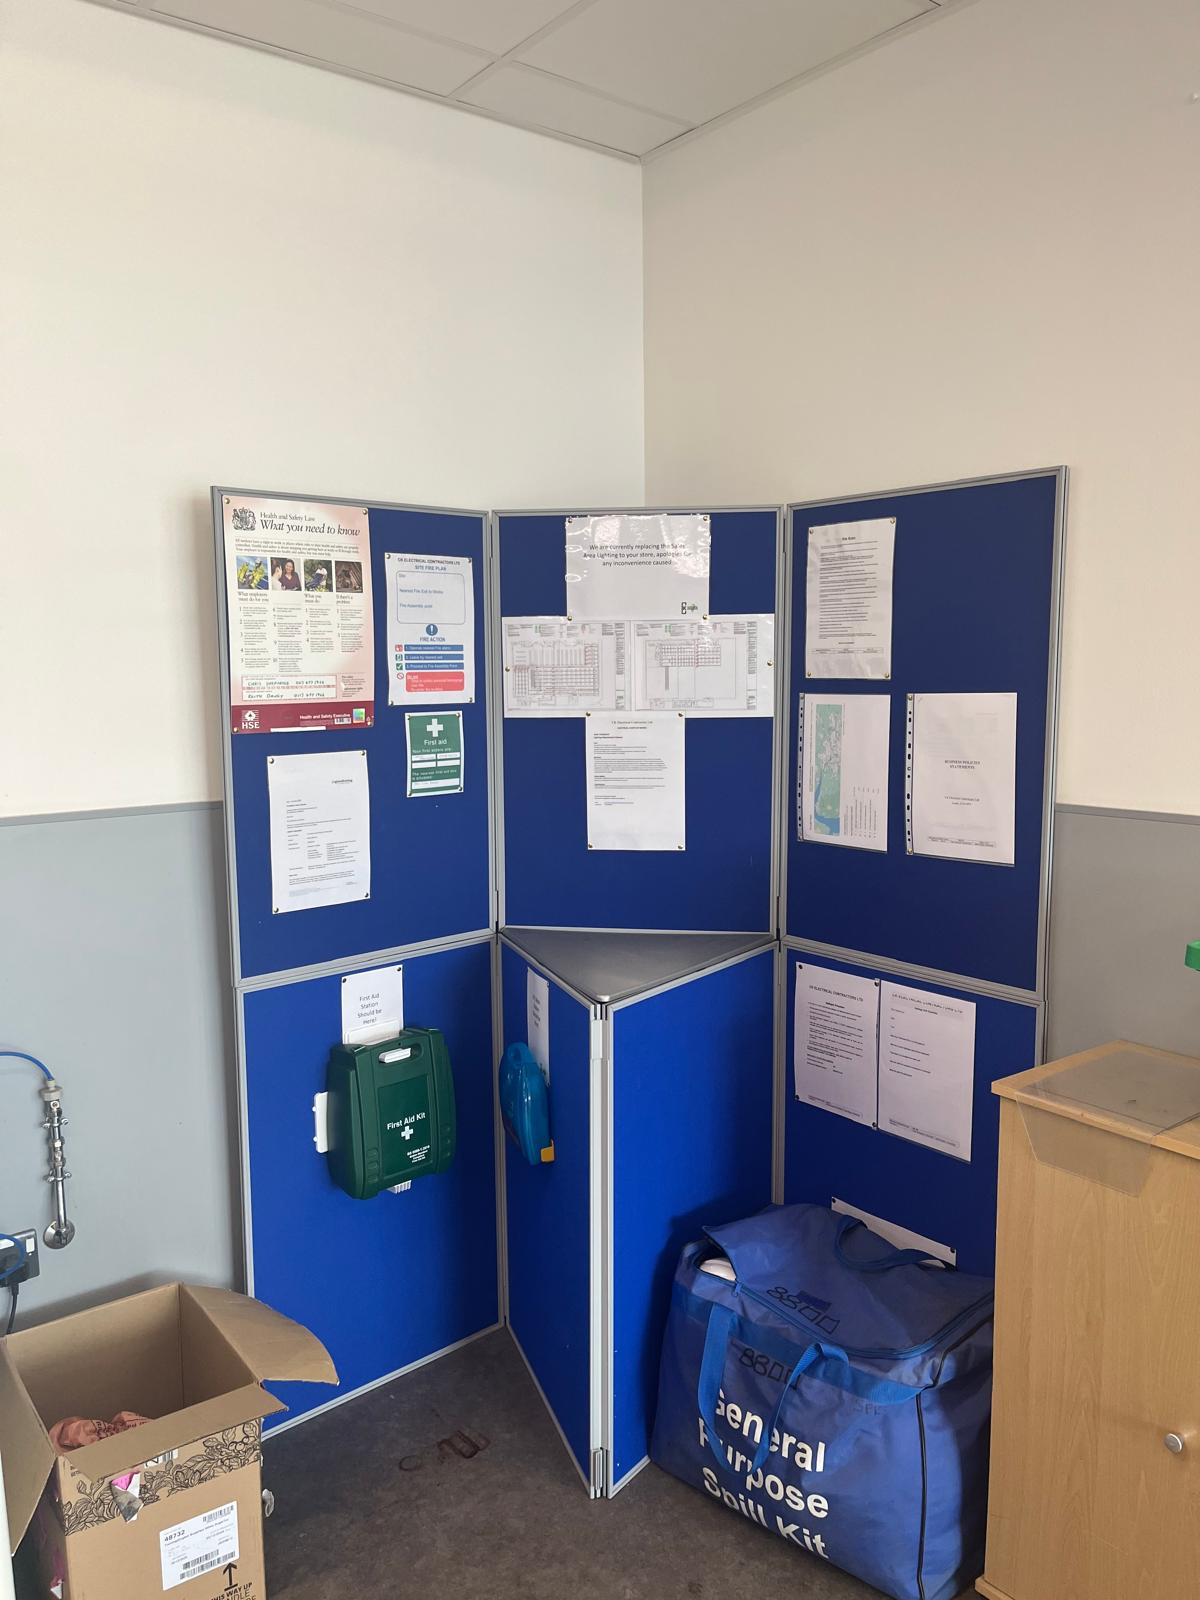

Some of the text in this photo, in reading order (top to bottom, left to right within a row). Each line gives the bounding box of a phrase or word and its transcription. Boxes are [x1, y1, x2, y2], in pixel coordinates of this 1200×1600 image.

[289, 513, 303, 521] Safety
[260, 519, 284, 530] What
[287, 523, 303, 534] you
[305, 523, 325, 533] need
[337, 525, 360, 536] know
[358, 1010, 374, 1018] Should
[387, 1112, 426, 1130] First Aid Kit
[702, 1467, 829, 1559] Spill Kit
[226, 1586, 242, 1597] WAY
